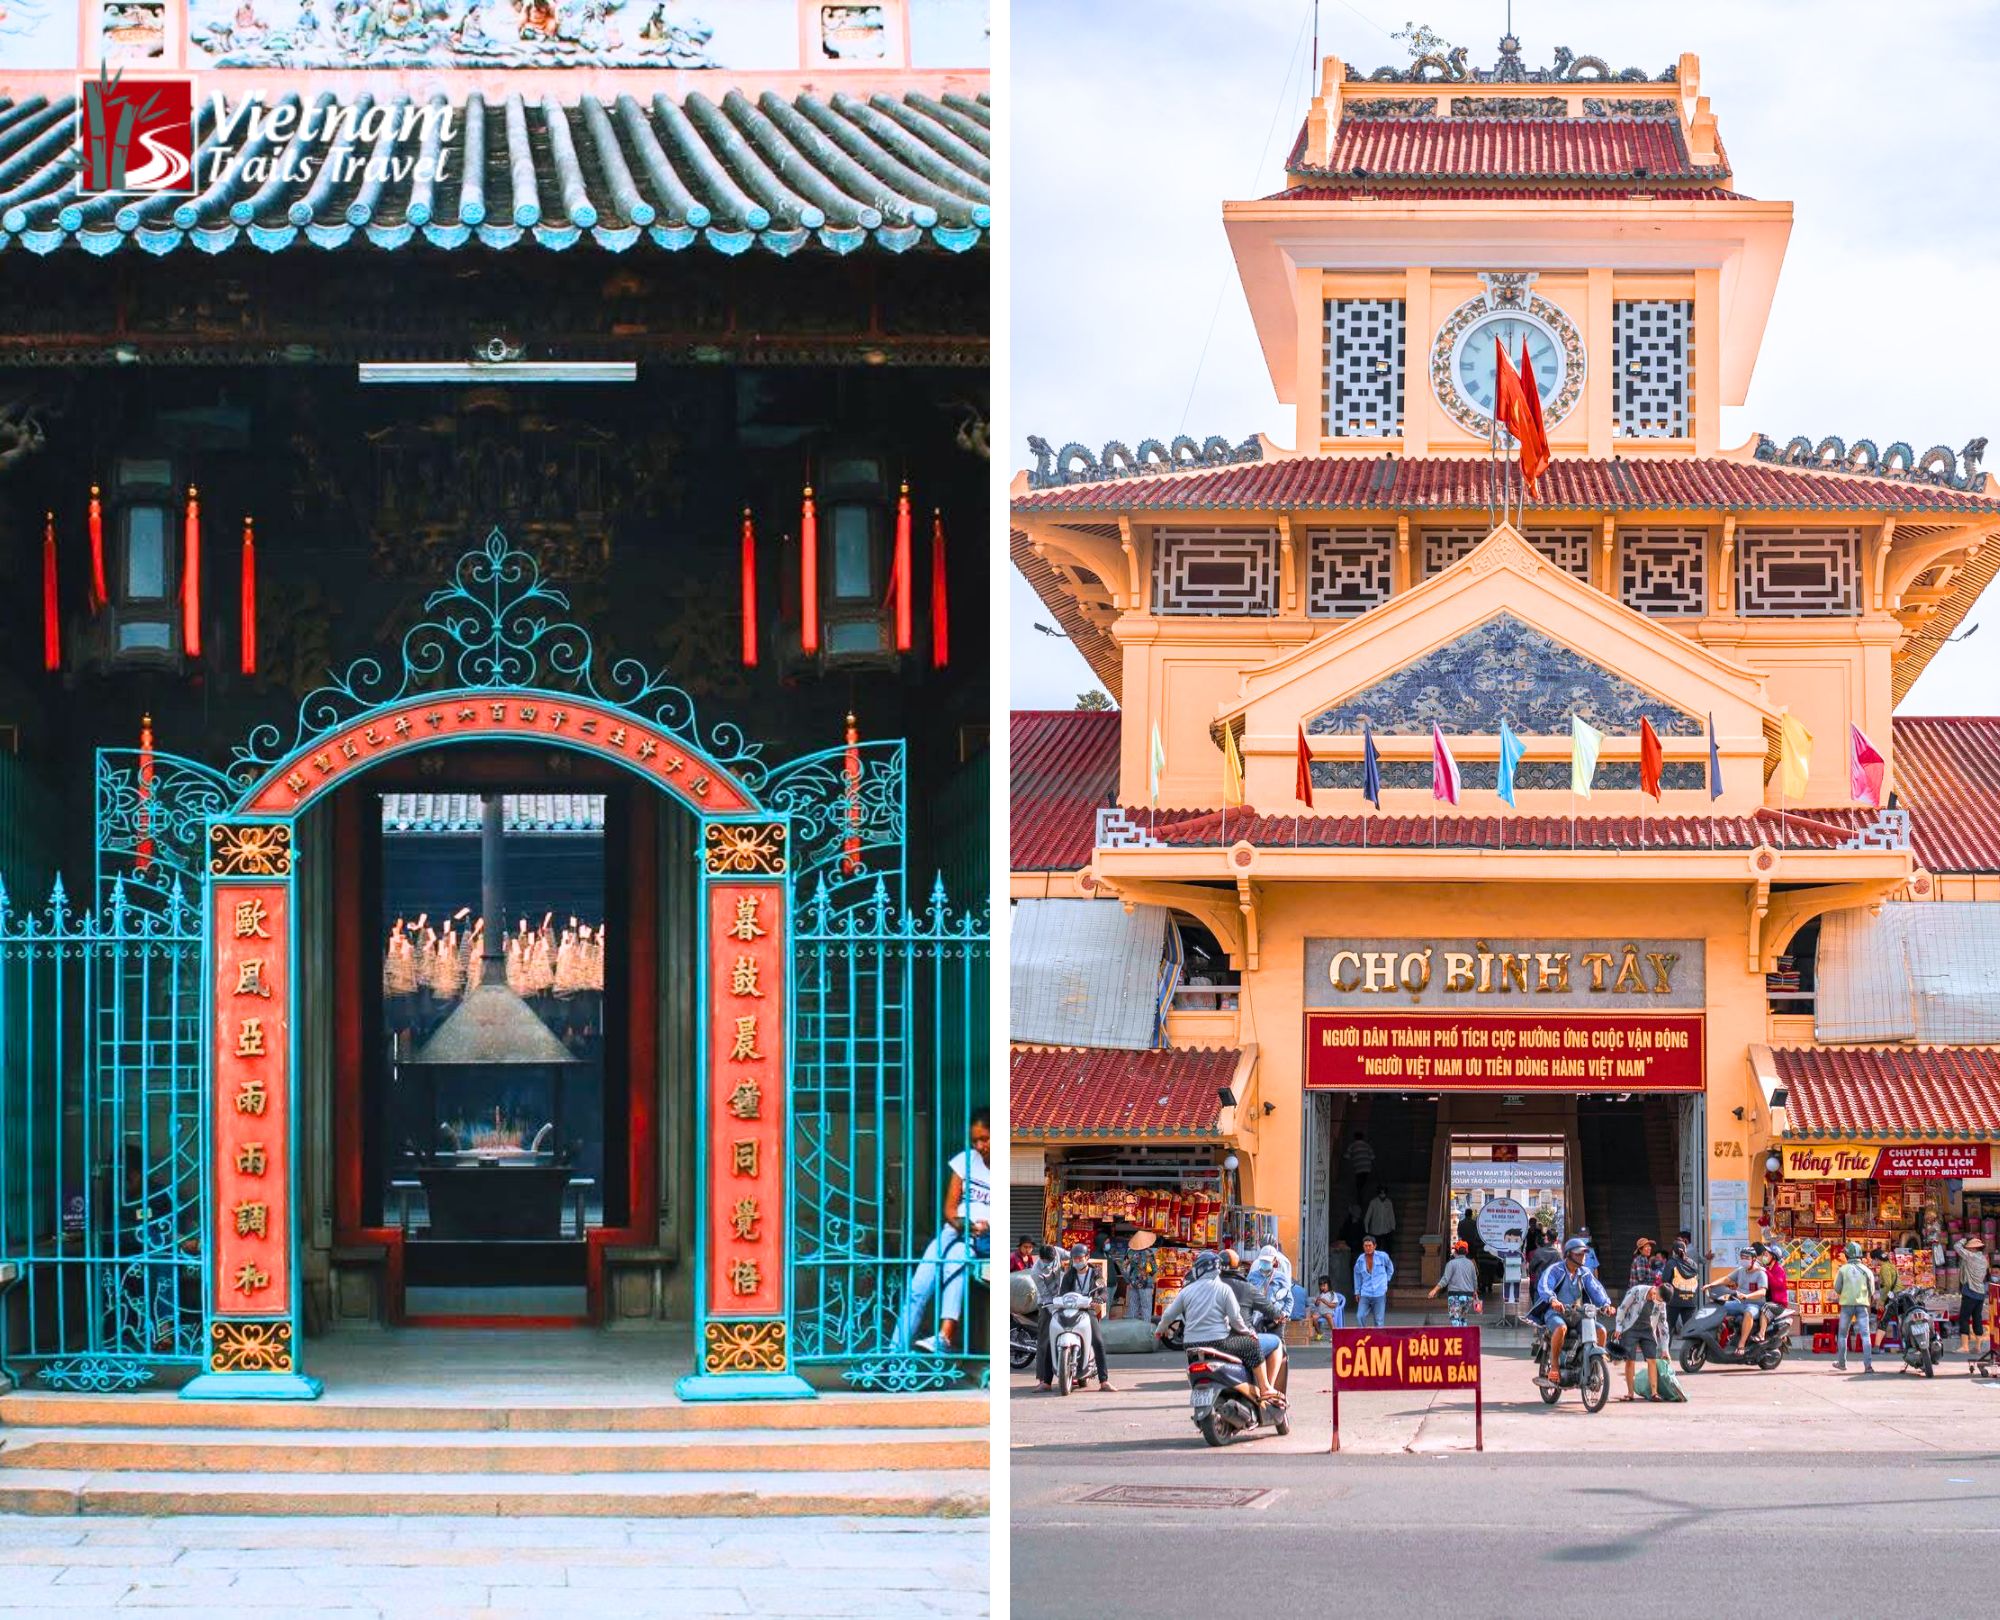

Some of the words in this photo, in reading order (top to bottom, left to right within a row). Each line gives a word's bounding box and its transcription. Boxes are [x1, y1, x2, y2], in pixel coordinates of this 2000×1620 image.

[1328, 943, 1433, 1003] CHỢ
[1443, 941, 1571, 994] BÌNH
[1581, 943, 1679, 994] TÂY
[1322, 1026, 1360, 1047] NGƯỜI
[1363, 1026, 1388, 1047] DÂN
[1391, 1026, 1430, 1047] THÀNH
[1434, 1024, 1459, 1047] PHỐ
[1462, 1026, 1488, 1047] TÍCH
[1492, 1028, 1516, 1051] CỰC
[1519, 1025, 1560, 1048] HƯỞNG
[1563, 1027, 1588, 1048] ỨNG
[1592, 1027, 1624, 1052] CUỘC
[1627, 1027, 1651, 1052] VẬN
[1654, 1027, 1689, 1052] ĐỘNG
[1406, 1055, 1431, 1079] VIỆT
[1434, 1058, 1462, 1076] NAM
[1466, 1056, 1482, 1076] ƯU
[1485, 1056, 1512, 1076] TIÊN
[1515, 1056, 1548, 1076] DÙNG
[1552, 1056, 1584, 1076] HÀNG
[1587, 1056, 1613, 1080] VIỆT
[1714, 1141, 1743, 1157] 57A
[1952, 1148, 1961, 1156] &
[1835, 1151, 1870, 1171] Trúc
[1892, 1157, 1913, 1167] CÁC
[1917, 1159, 1944, 1168] LOẠI
[1948, 1158, 1974, 1168] LỊCH
[1335, 1335, 1392, 1378] CẤM
[1408, 1334, 1439, 1360] ĐẬU
[1444, 1337, 1463, 1356] XE
[1409, 1366, 1443, 1383] MUA
[1447, 1361, 1477, 1383] BÁN
